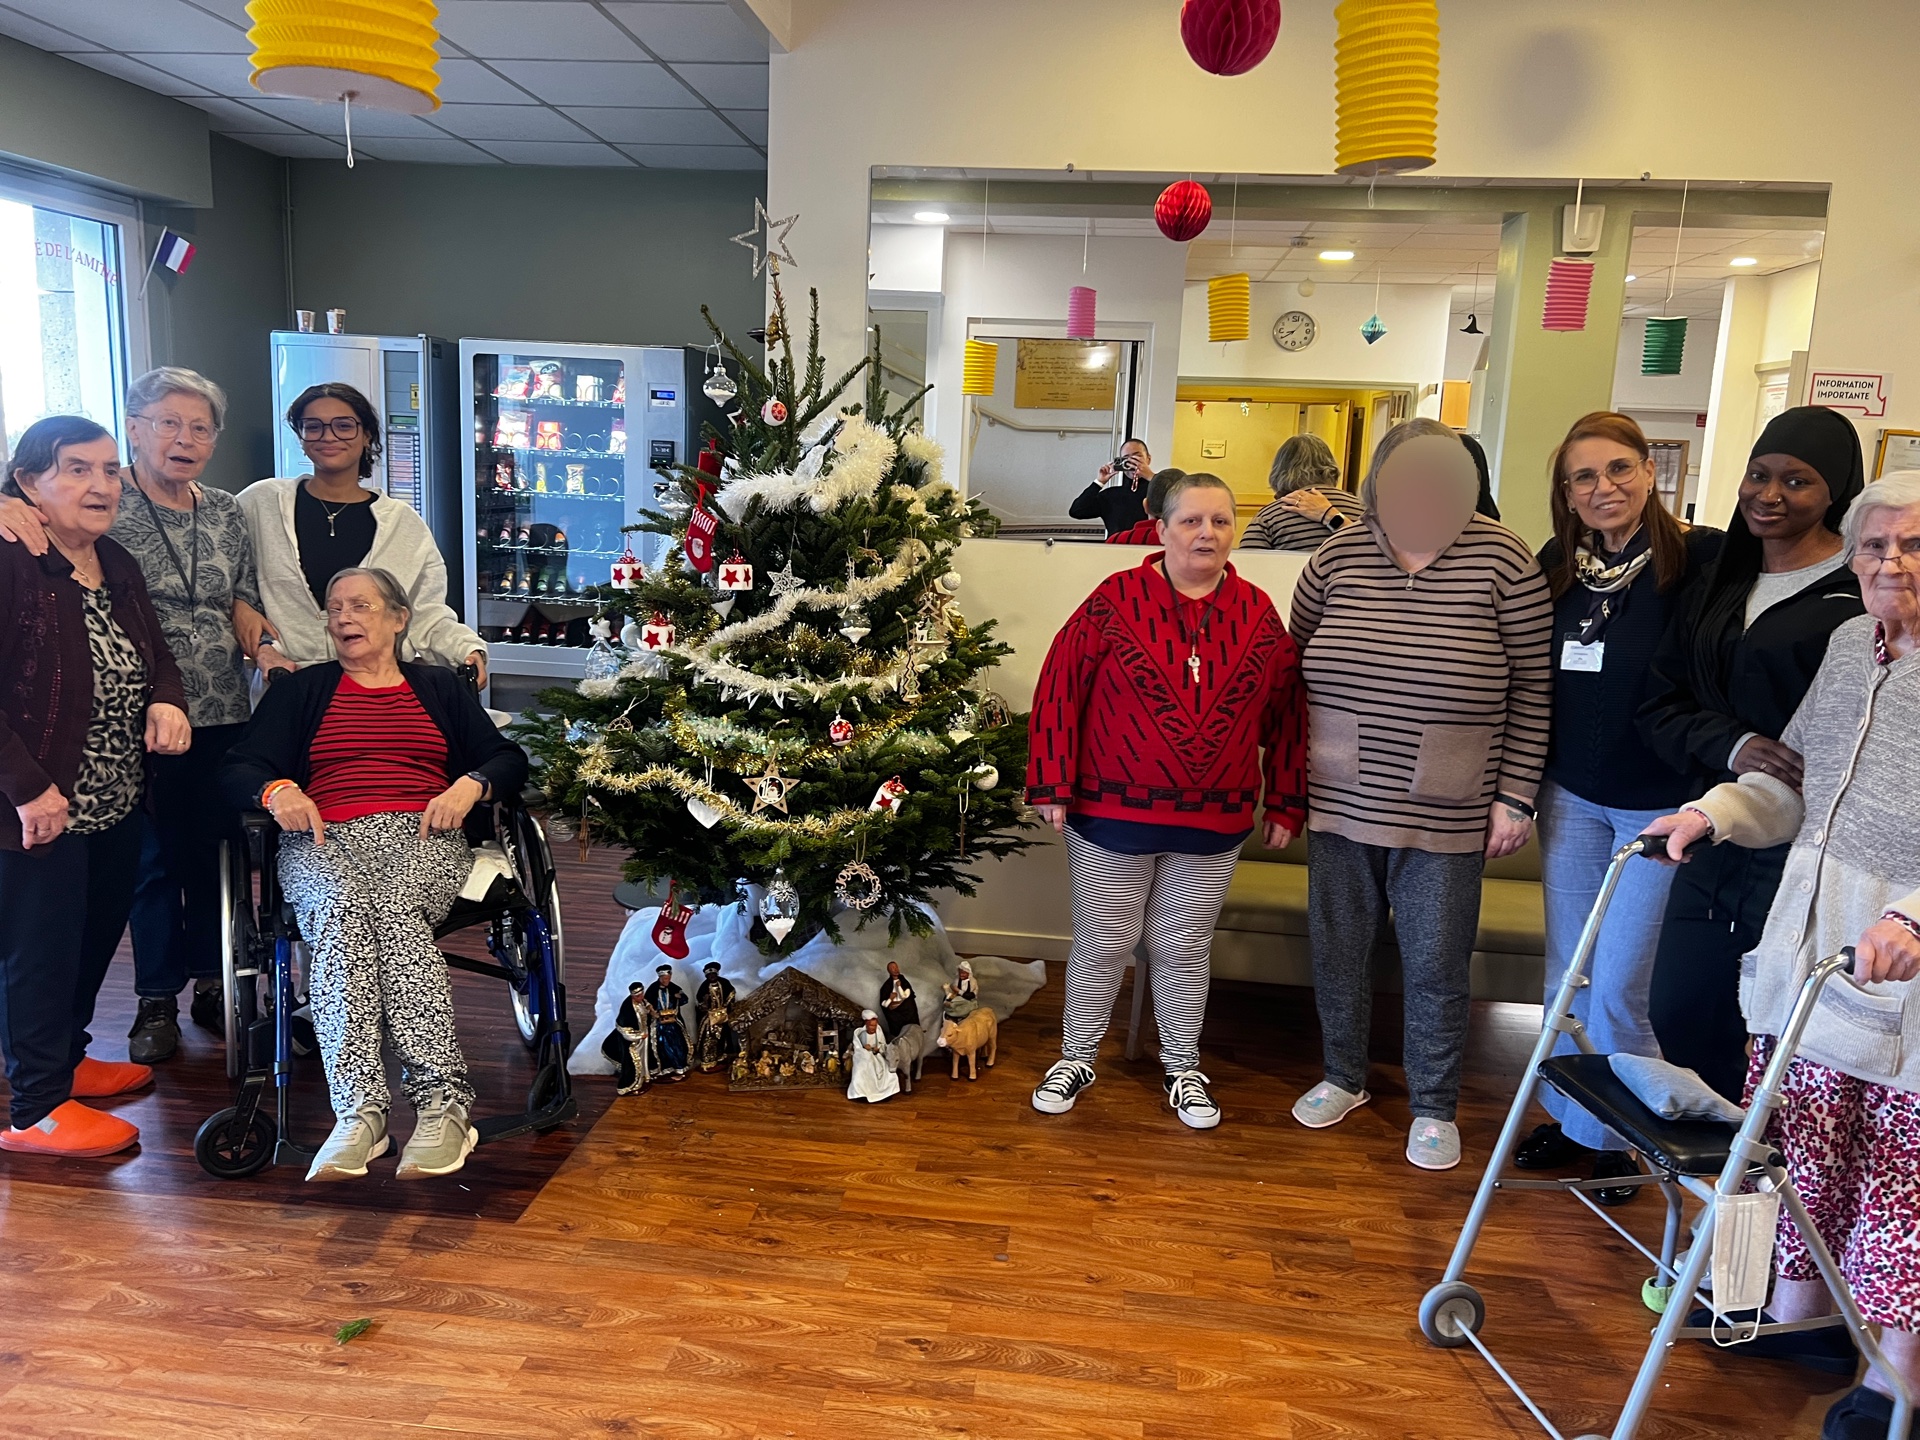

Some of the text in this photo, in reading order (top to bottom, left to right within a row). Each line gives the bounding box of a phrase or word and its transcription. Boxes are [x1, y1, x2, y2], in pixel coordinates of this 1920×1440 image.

[45, 242, 62, 257] DE
[1816, 379, 1874, 389] INFORMATION
[1817, 390, 1870, 400] IMPORTANTE
